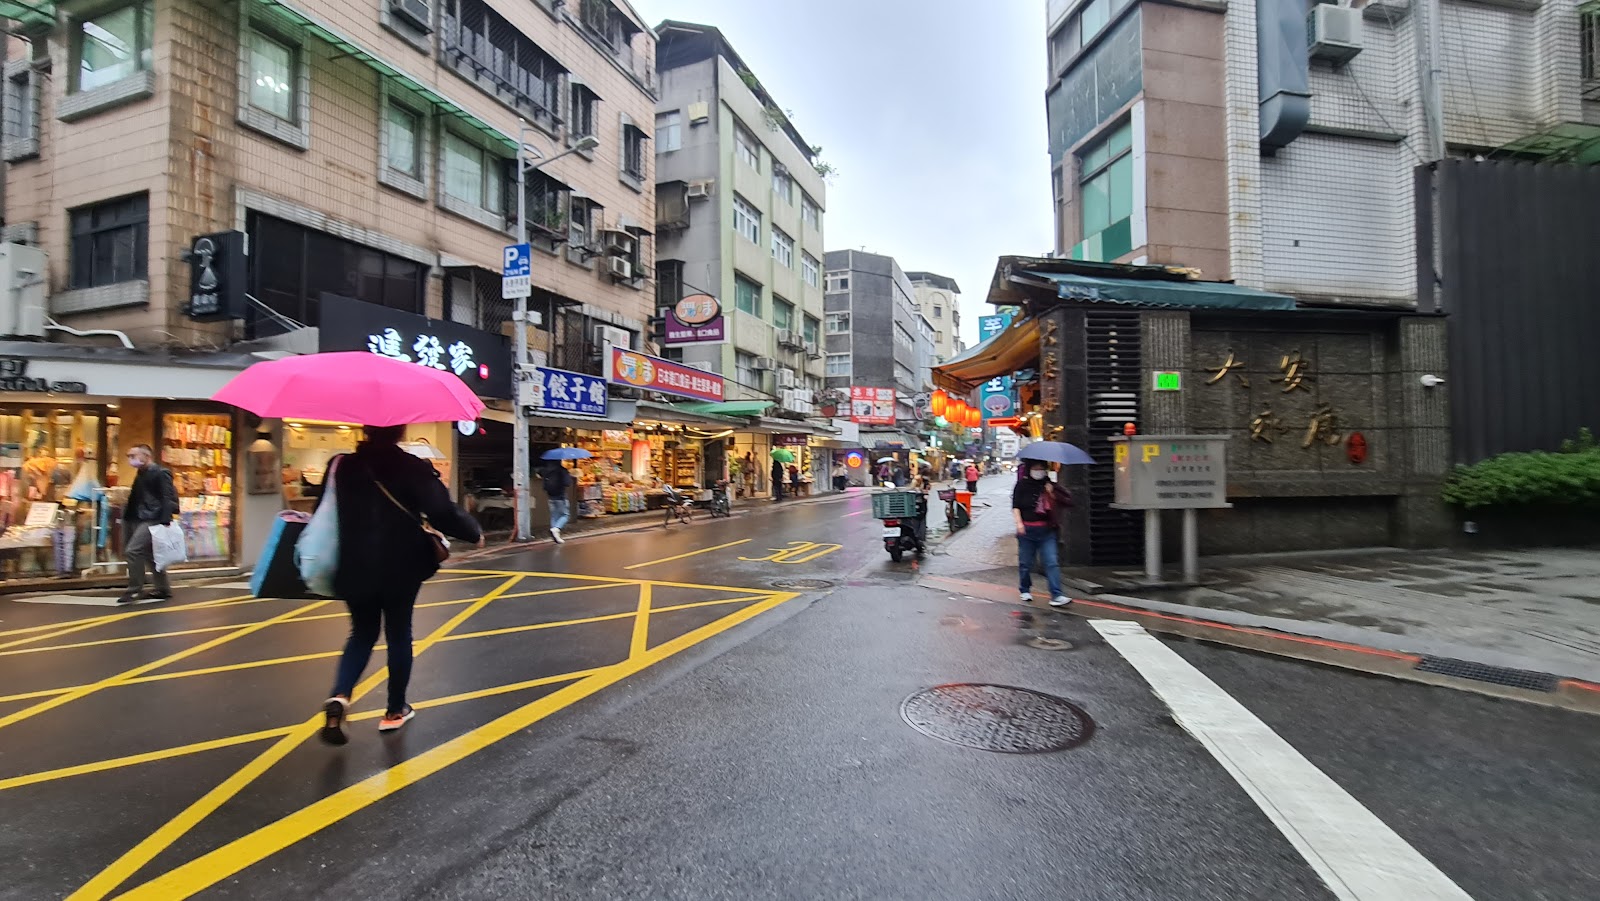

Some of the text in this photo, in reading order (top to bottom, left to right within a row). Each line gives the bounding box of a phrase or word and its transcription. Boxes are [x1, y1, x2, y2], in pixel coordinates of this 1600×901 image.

[505, 247, 519, 268] P
[1141, 444, 1160, 463] P
[737, 541, 843, 564] 30
